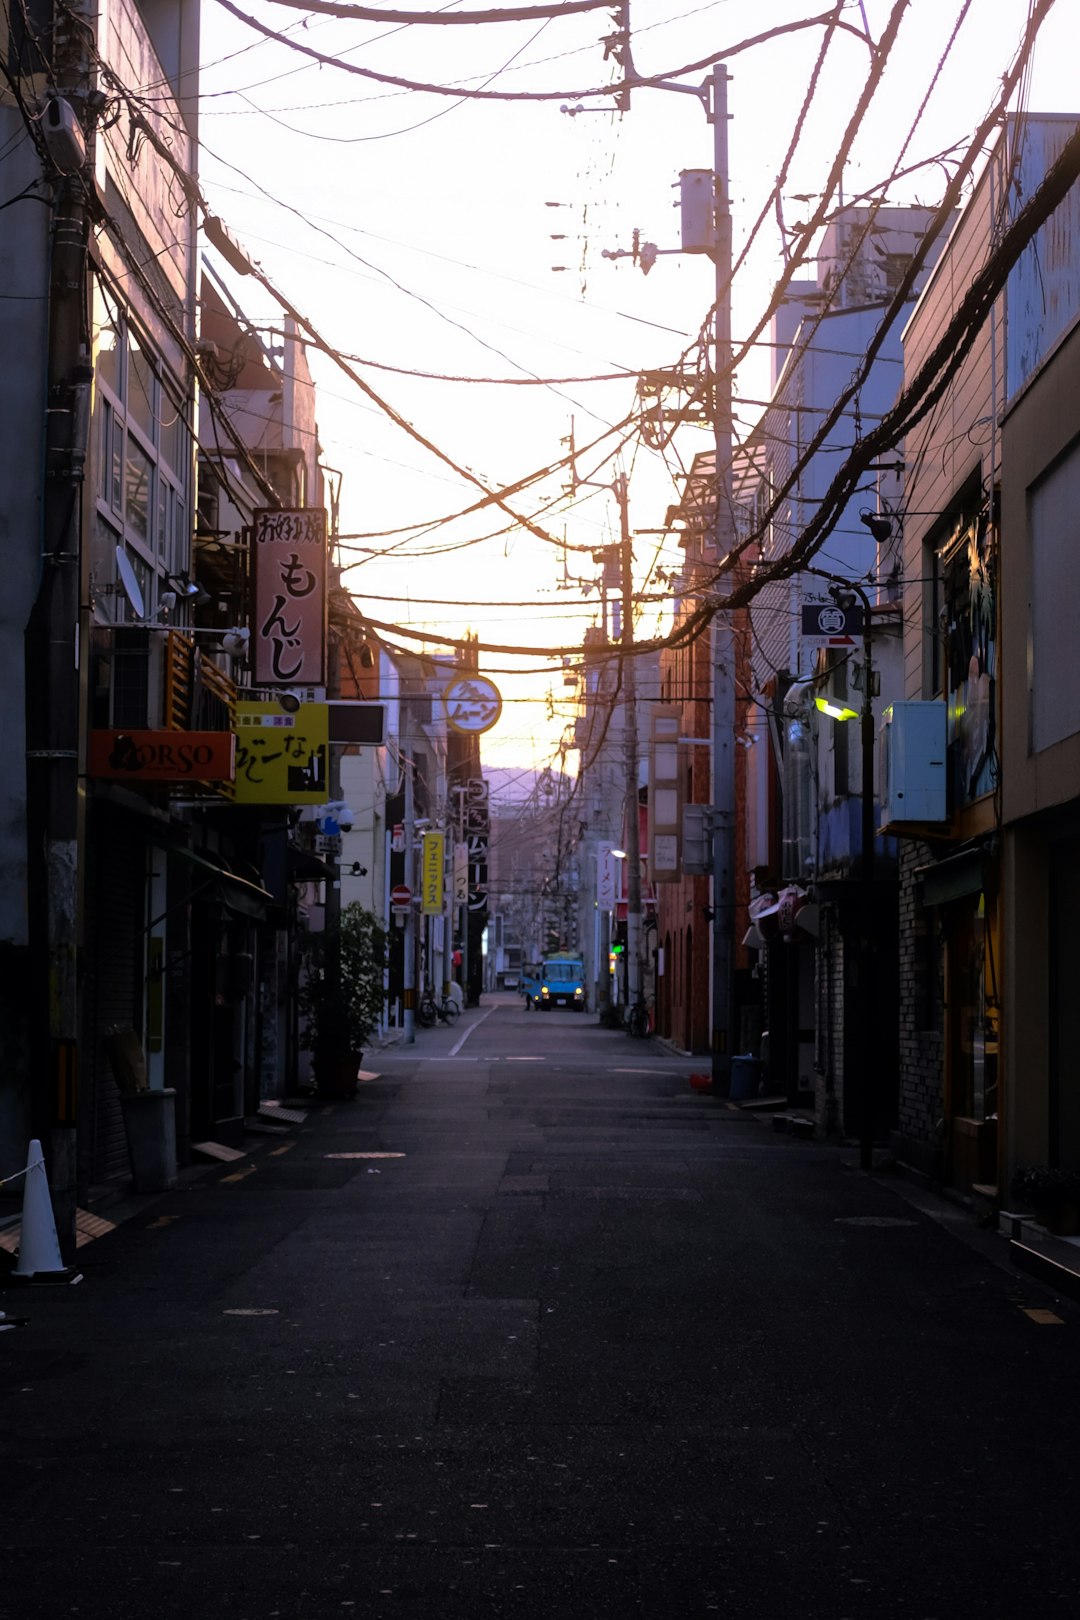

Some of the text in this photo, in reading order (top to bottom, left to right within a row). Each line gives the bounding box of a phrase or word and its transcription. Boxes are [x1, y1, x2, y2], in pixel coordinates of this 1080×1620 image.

[262, 553, 316, 680] もんじ
[451, 703, 497, 722] ムーン
[428, 841, 439, 904] フェニックス
[601, 846, 611, 896] ラーメン
